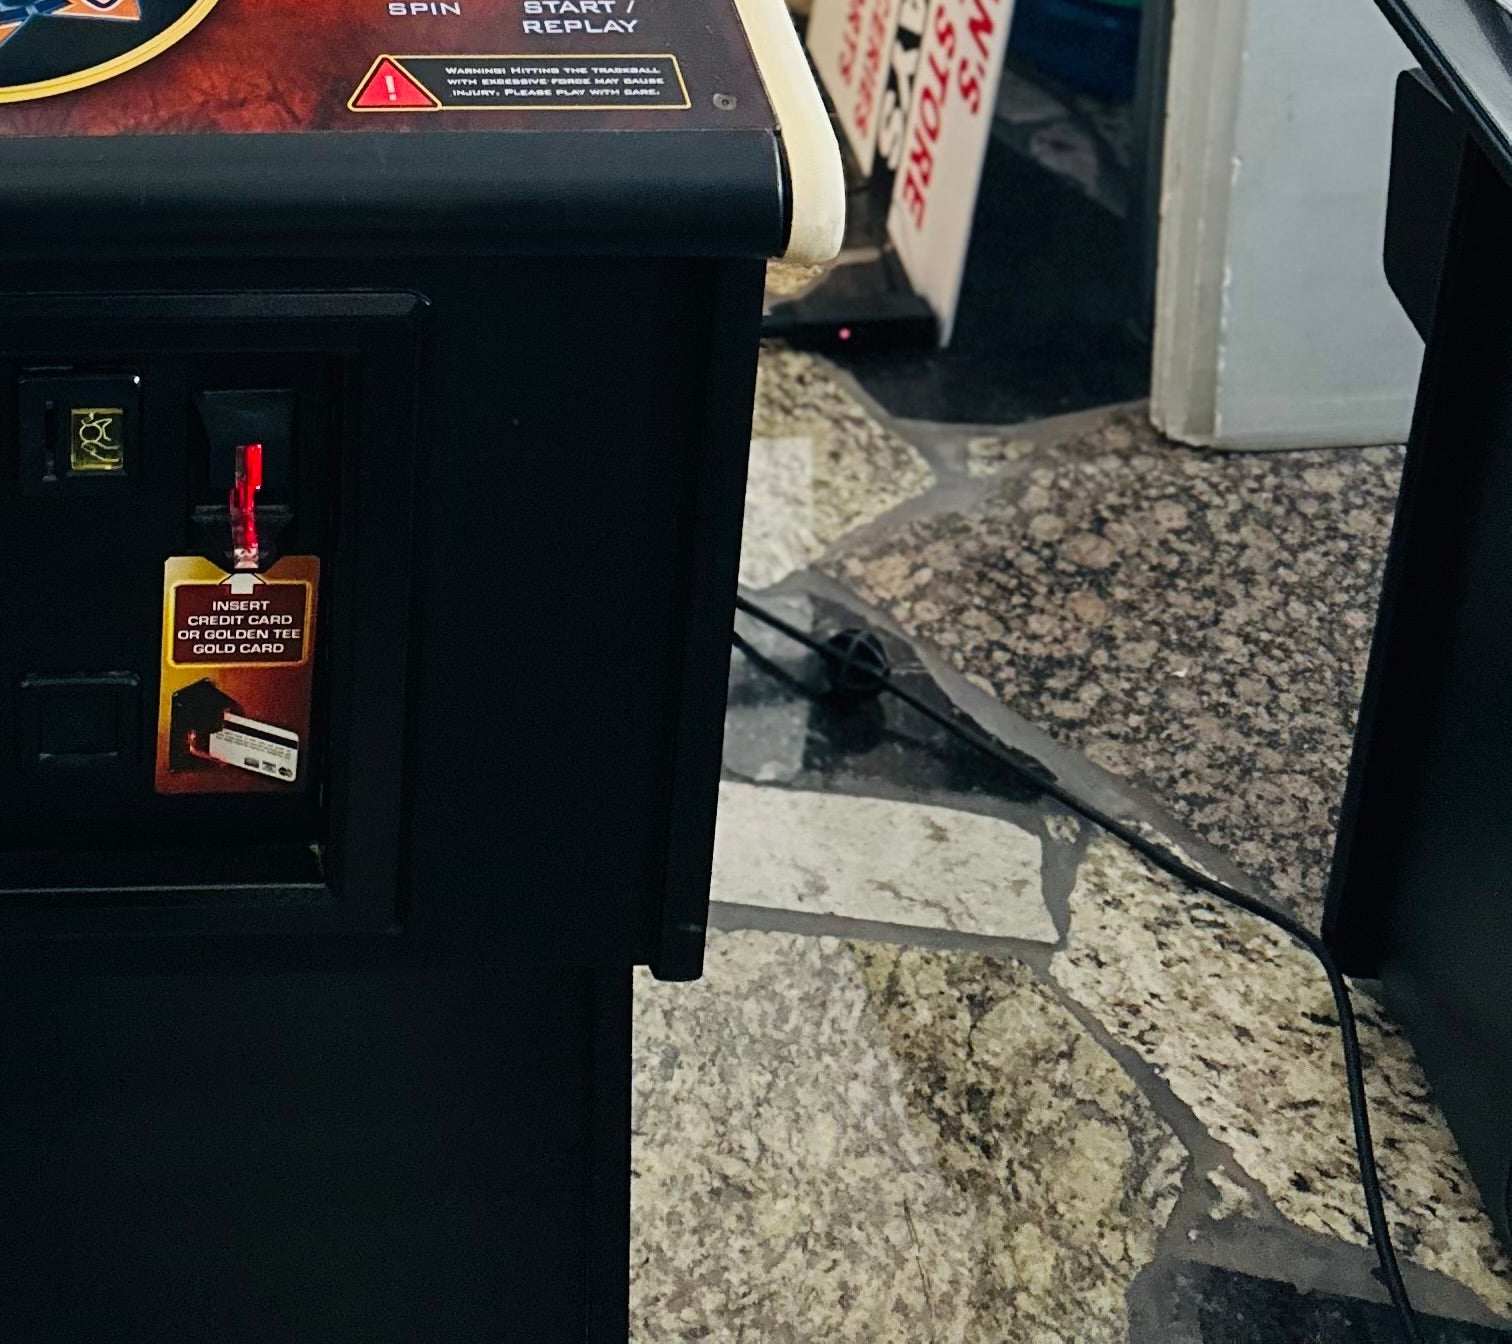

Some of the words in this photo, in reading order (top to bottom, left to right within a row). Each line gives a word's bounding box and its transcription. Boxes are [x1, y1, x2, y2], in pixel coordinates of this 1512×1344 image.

[389, 2, 461, 16] SPIN
[524, 0, 616, 14] START
[522, 20, 638, 34] REPLAY
[903, 6, 956, 230] STORE
[212, 600, 270, 611] INSERT
[188, 615, 244, 626] CREDIT
[248, 615, 293, 625] CARD
[177, 629, 200, 639] OR
[204, 629, 268, 639] GOLDEN
[273, 628, 301, 639] TEE
[193, 643, 236, 654] GOLD
[239, 643, 284, 654] CARD
